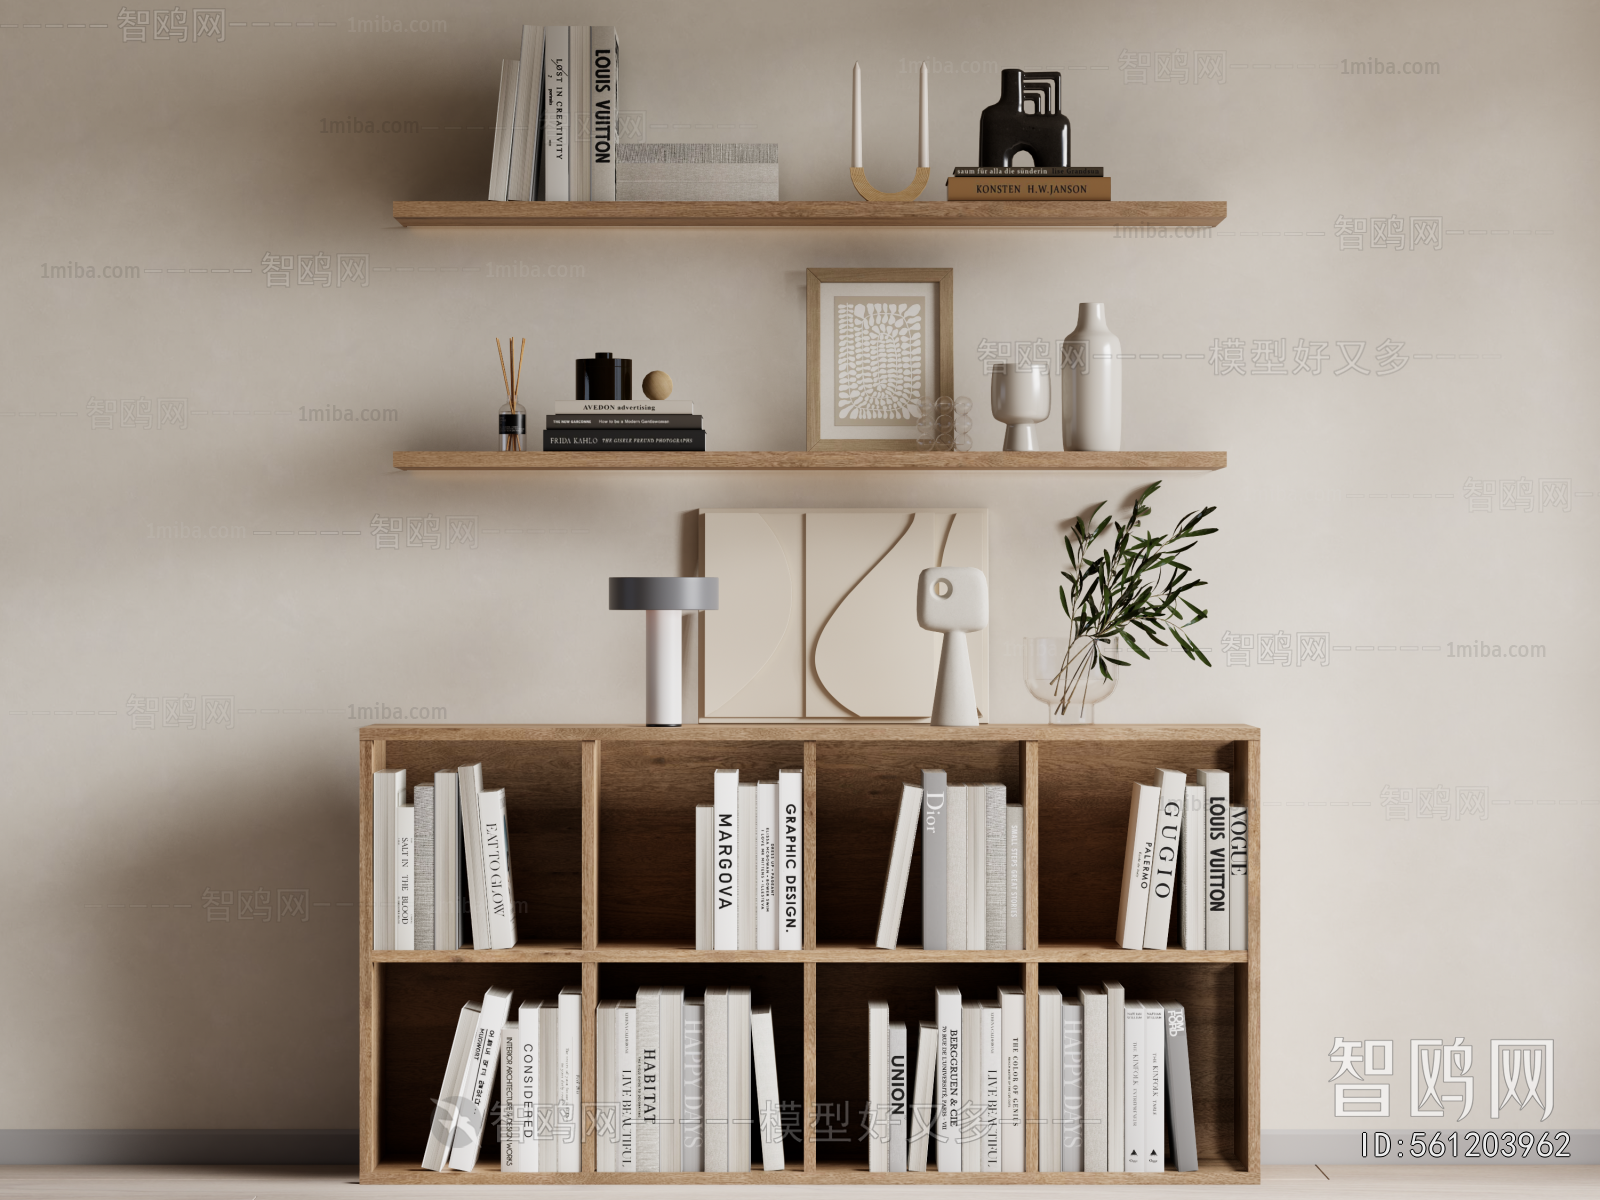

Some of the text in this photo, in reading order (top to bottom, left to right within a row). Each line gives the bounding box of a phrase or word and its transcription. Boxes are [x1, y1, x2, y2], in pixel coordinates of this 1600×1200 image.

[555, 86, 563, 98] IN
[555, 101, 563, 160] CREATIVITY
[595, 49, 611, 163] LOUIS VUITTON
[976, 184, 1087, 196] KONSTEN H.W.JANSON
[617, 404, 656, 412] advertising
[926, 791, 945, 834] Dior
[1155, 801, 1180, 898] GUGIO
[1230, 809, 1248, 876] VOGUE
[401, 837, 409, 925] SALT IN THE BLOOD
[486, 822, 506, 918] EAT TO GLOW
[718, 813, 733, 910] MARGOVA
[785, 803, 797, 933] GRAPHIC DESIGN.
[1010, 824, 1018, 918] SMALL STEPS GREAT STORIES
[1140, 842, 1153, 890] PALERMO
[1210, 796, 1225, 912] LOUIS VUITTON
[473, 1027, 486, 1061] MUGWORT
[941, 1047, 947, 1056] DE
[1168, 1010, 1177, 1037] FORD
[1174, 1009, 1185, 1032] TOM
[523, 1043, 533, 1138] CONSIDERED
[621, 1070, 632, 1167] LIVE BEAUTIFUL
[643, 1048, 657, 1124] HABITAT
[684, 1019, 704, 1148] HAPPY DAYS
[890, 1055, 905, 1115] UNION
[949, 1029, 958, 1127] BERGGRUEN & CIE
[987, 1070, 998, 1167] LIVE BEAUTIFUL
[1012, 1085, 1019, 1095] OF
[1063, 1019, 1082, 1148] HAPPY DAYS
